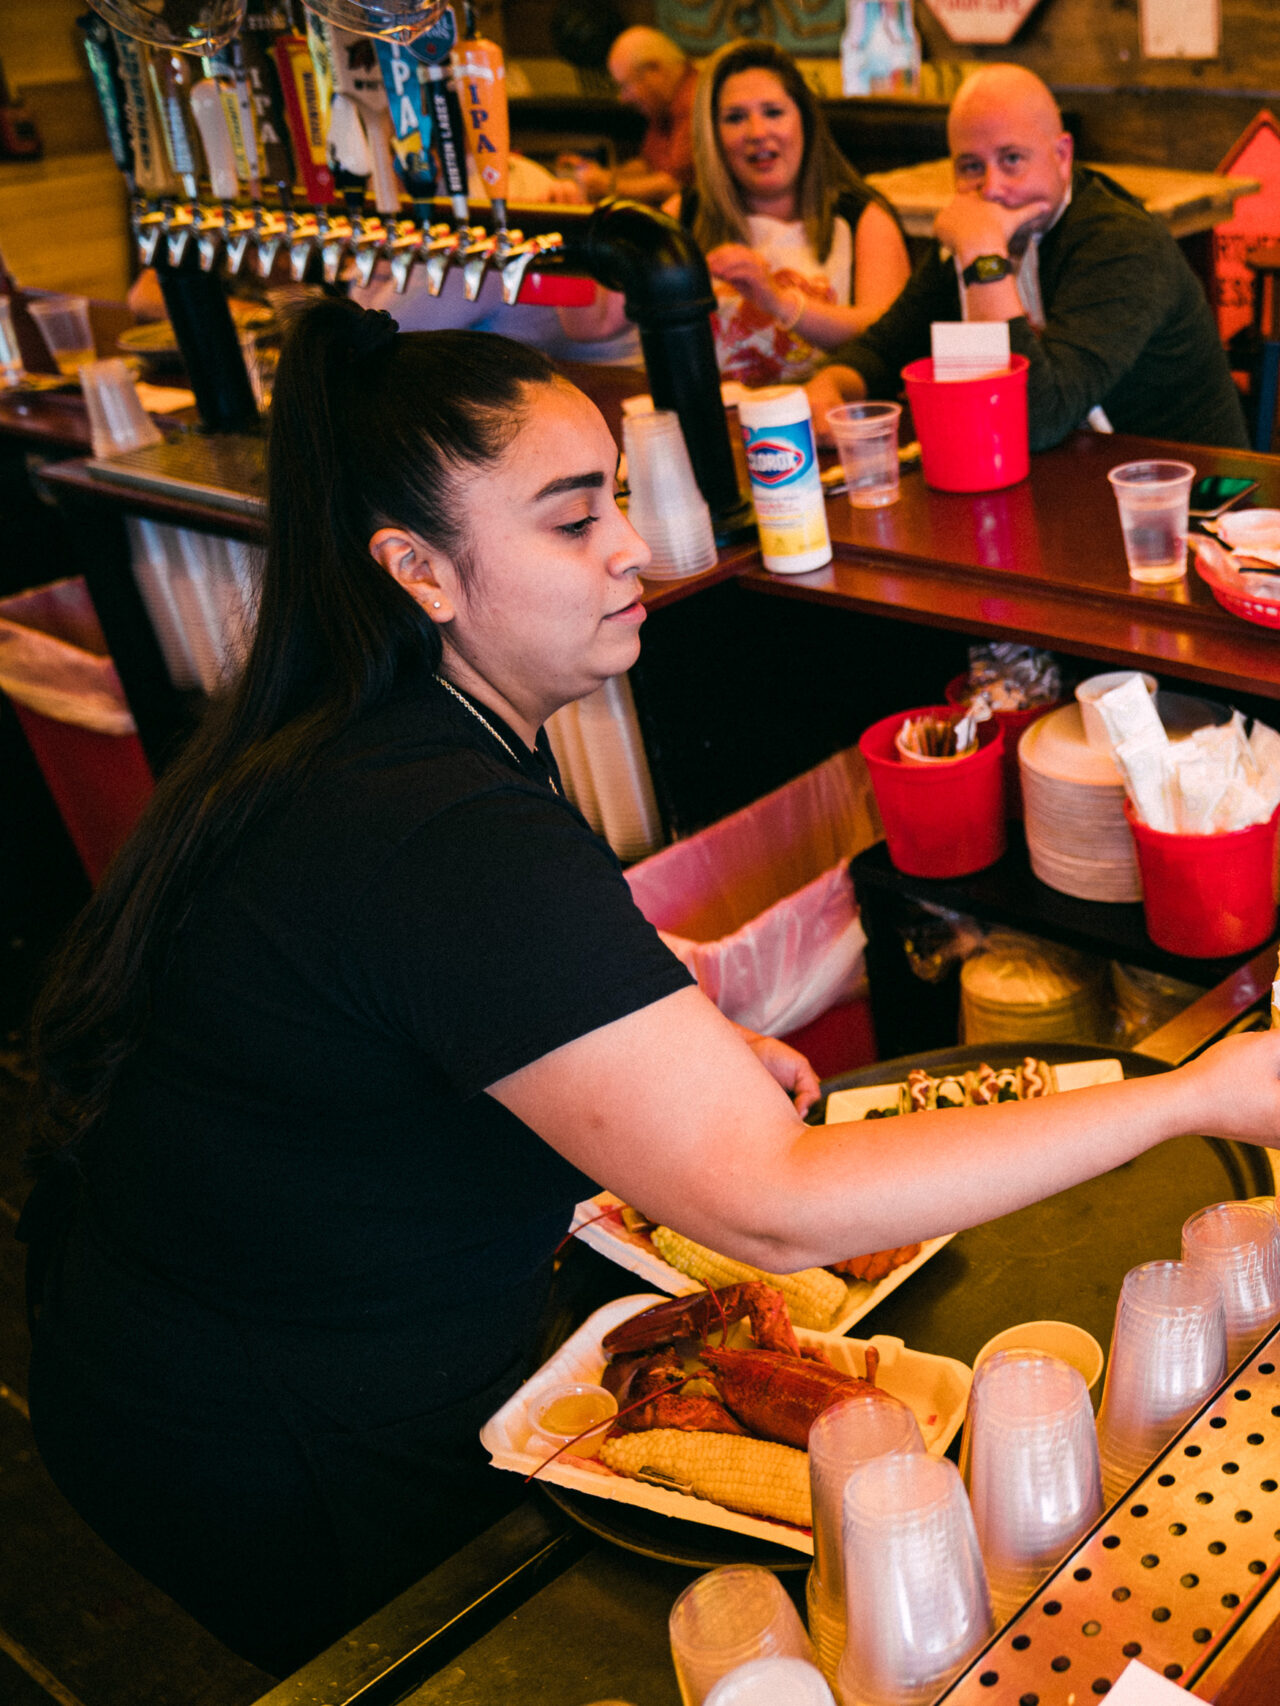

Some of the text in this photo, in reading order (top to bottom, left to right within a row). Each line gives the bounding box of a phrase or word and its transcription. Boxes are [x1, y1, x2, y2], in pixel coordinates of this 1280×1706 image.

[249, 67, 281, 144] IPA
[390, 30, 420, 137] IPA
[469, 83, 497, 154] IPA
